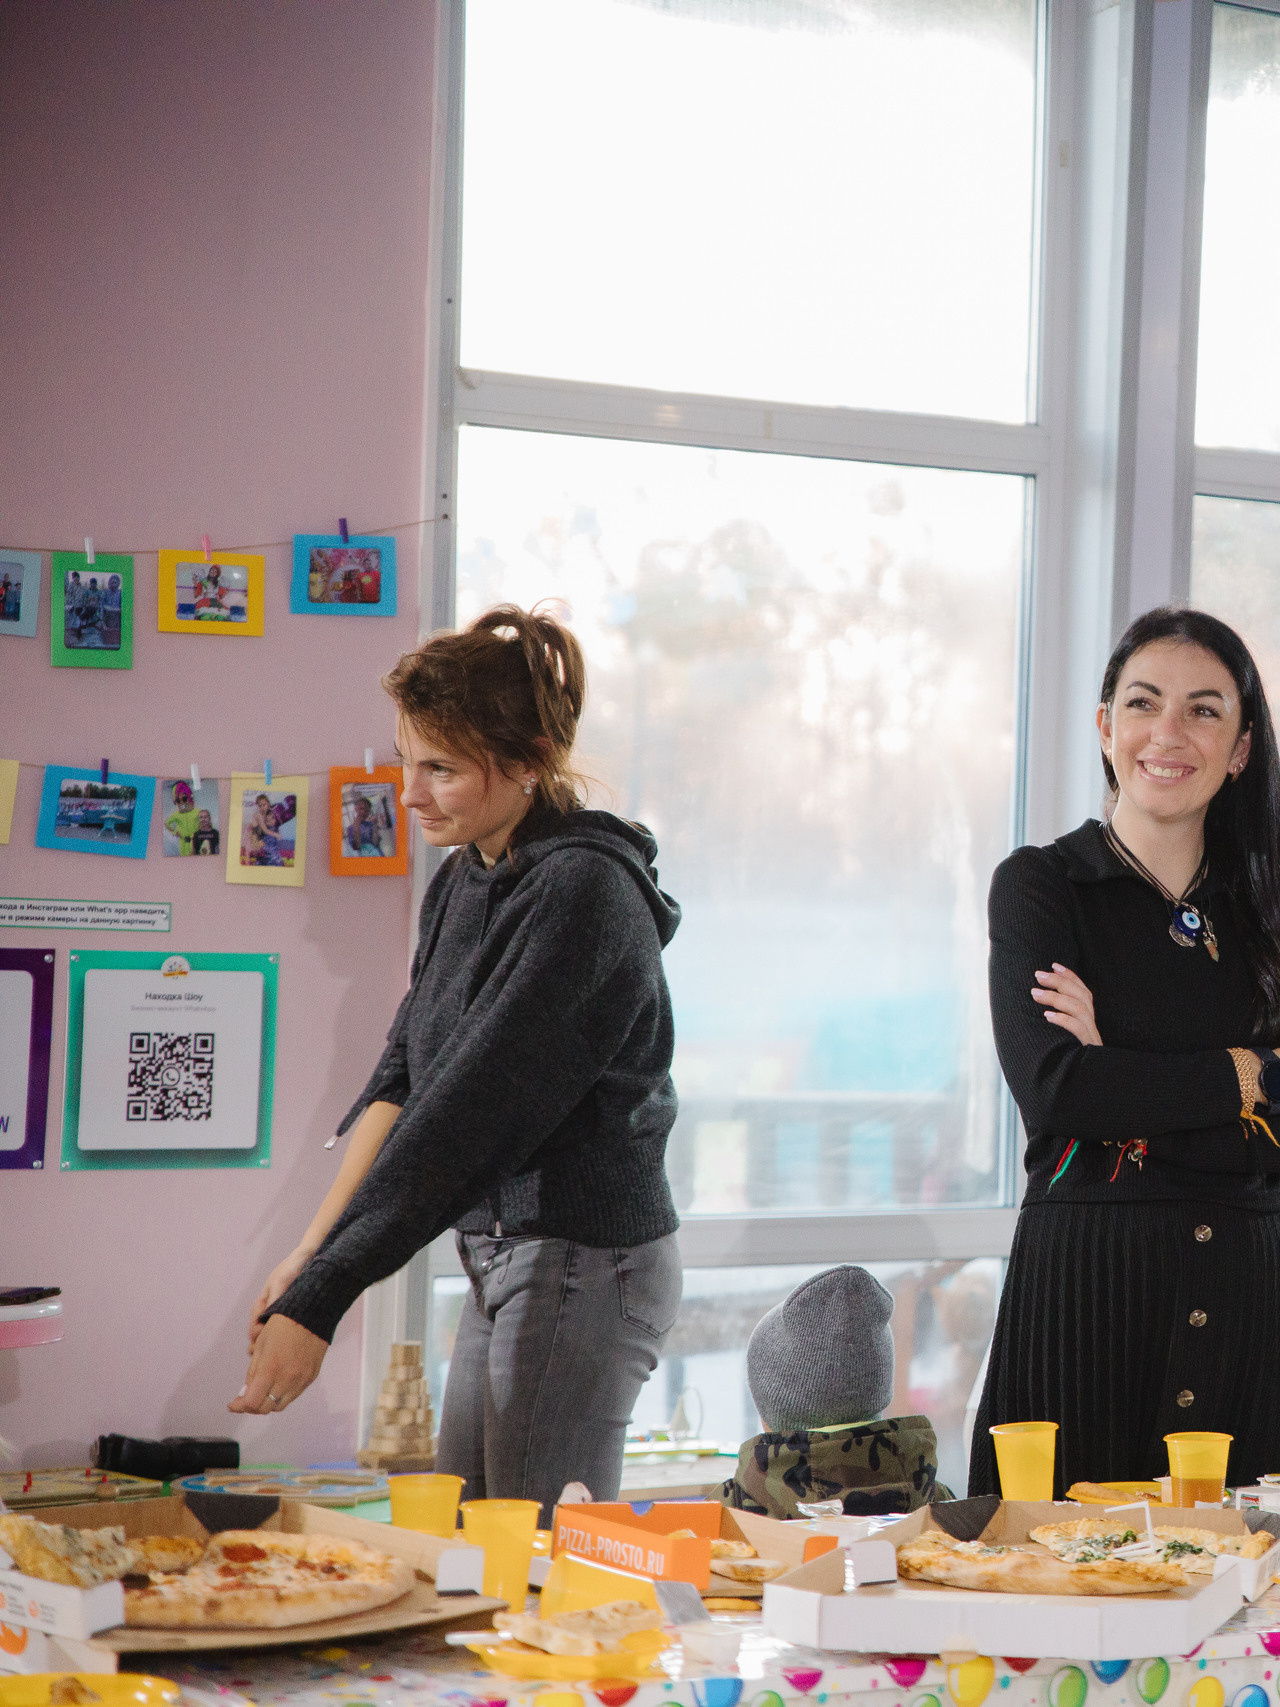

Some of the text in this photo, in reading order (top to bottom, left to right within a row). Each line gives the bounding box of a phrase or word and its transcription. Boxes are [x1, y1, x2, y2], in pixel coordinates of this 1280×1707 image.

[26, 903, 69, 913] Инстаграм
[70, 905, 85, 913] или
[86, 905, 112, 914] What's
[114, 907, 129, 916] app
[14, 914, 46, 922] режиме
[47, 916, 78, 924] камеры
[90, 916, 120, 925] данную
[122, 918, 156, 926] картинку
[144, 992, 204, 1002] Находка Шоу
[558, 1525, 665, 1576] PIZZA-PROSTO.RU
